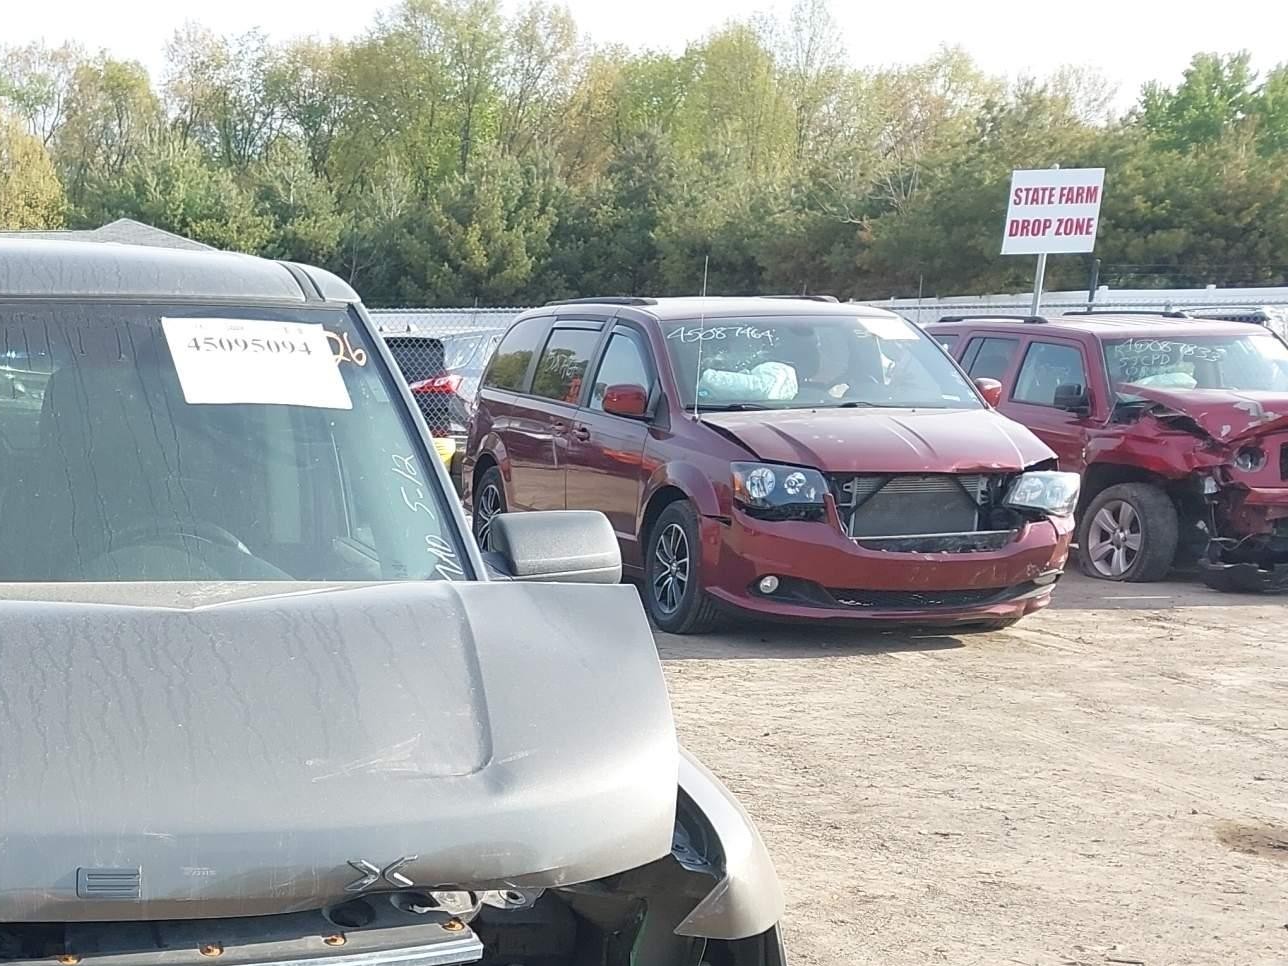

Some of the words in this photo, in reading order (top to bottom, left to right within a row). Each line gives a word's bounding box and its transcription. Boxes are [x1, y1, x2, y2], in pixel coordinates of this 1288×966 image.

[1013, 187, 1056, 206] STATE
[1058, 185, 1099, 204] FARM
[1008, 219, 1052, 237] DROP
[1054, 217, 1094, 236] ZONE
[187, 336, 313, 356] 45095094
